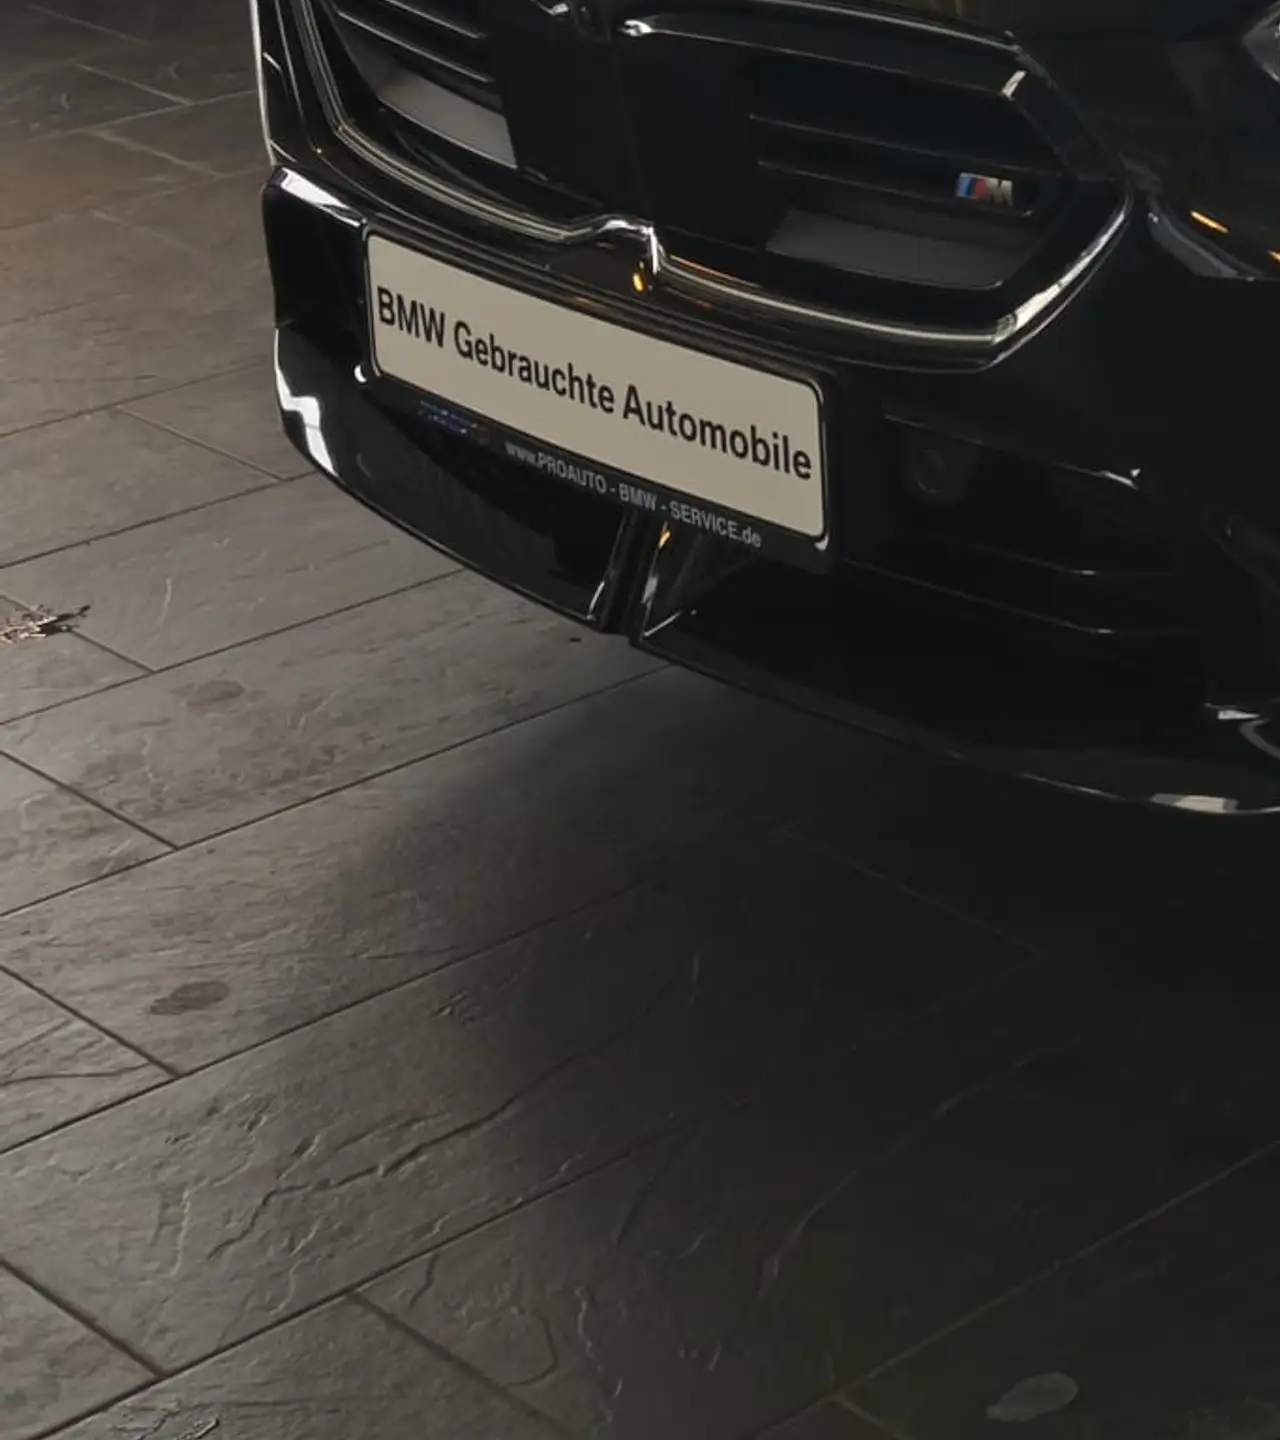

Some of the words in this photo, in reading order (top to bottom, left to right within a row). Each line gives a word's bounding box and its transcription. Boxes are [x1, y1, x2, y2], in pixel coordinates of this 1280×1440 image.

[376, 285, 447, 348] BMW
[453, 321, 616, 415] Gebrauchte
[622, 385, 814, 481] Automobile
[619, 483, 659, 512] BMW
[669, 501, 763, 549] SERVICE.de
